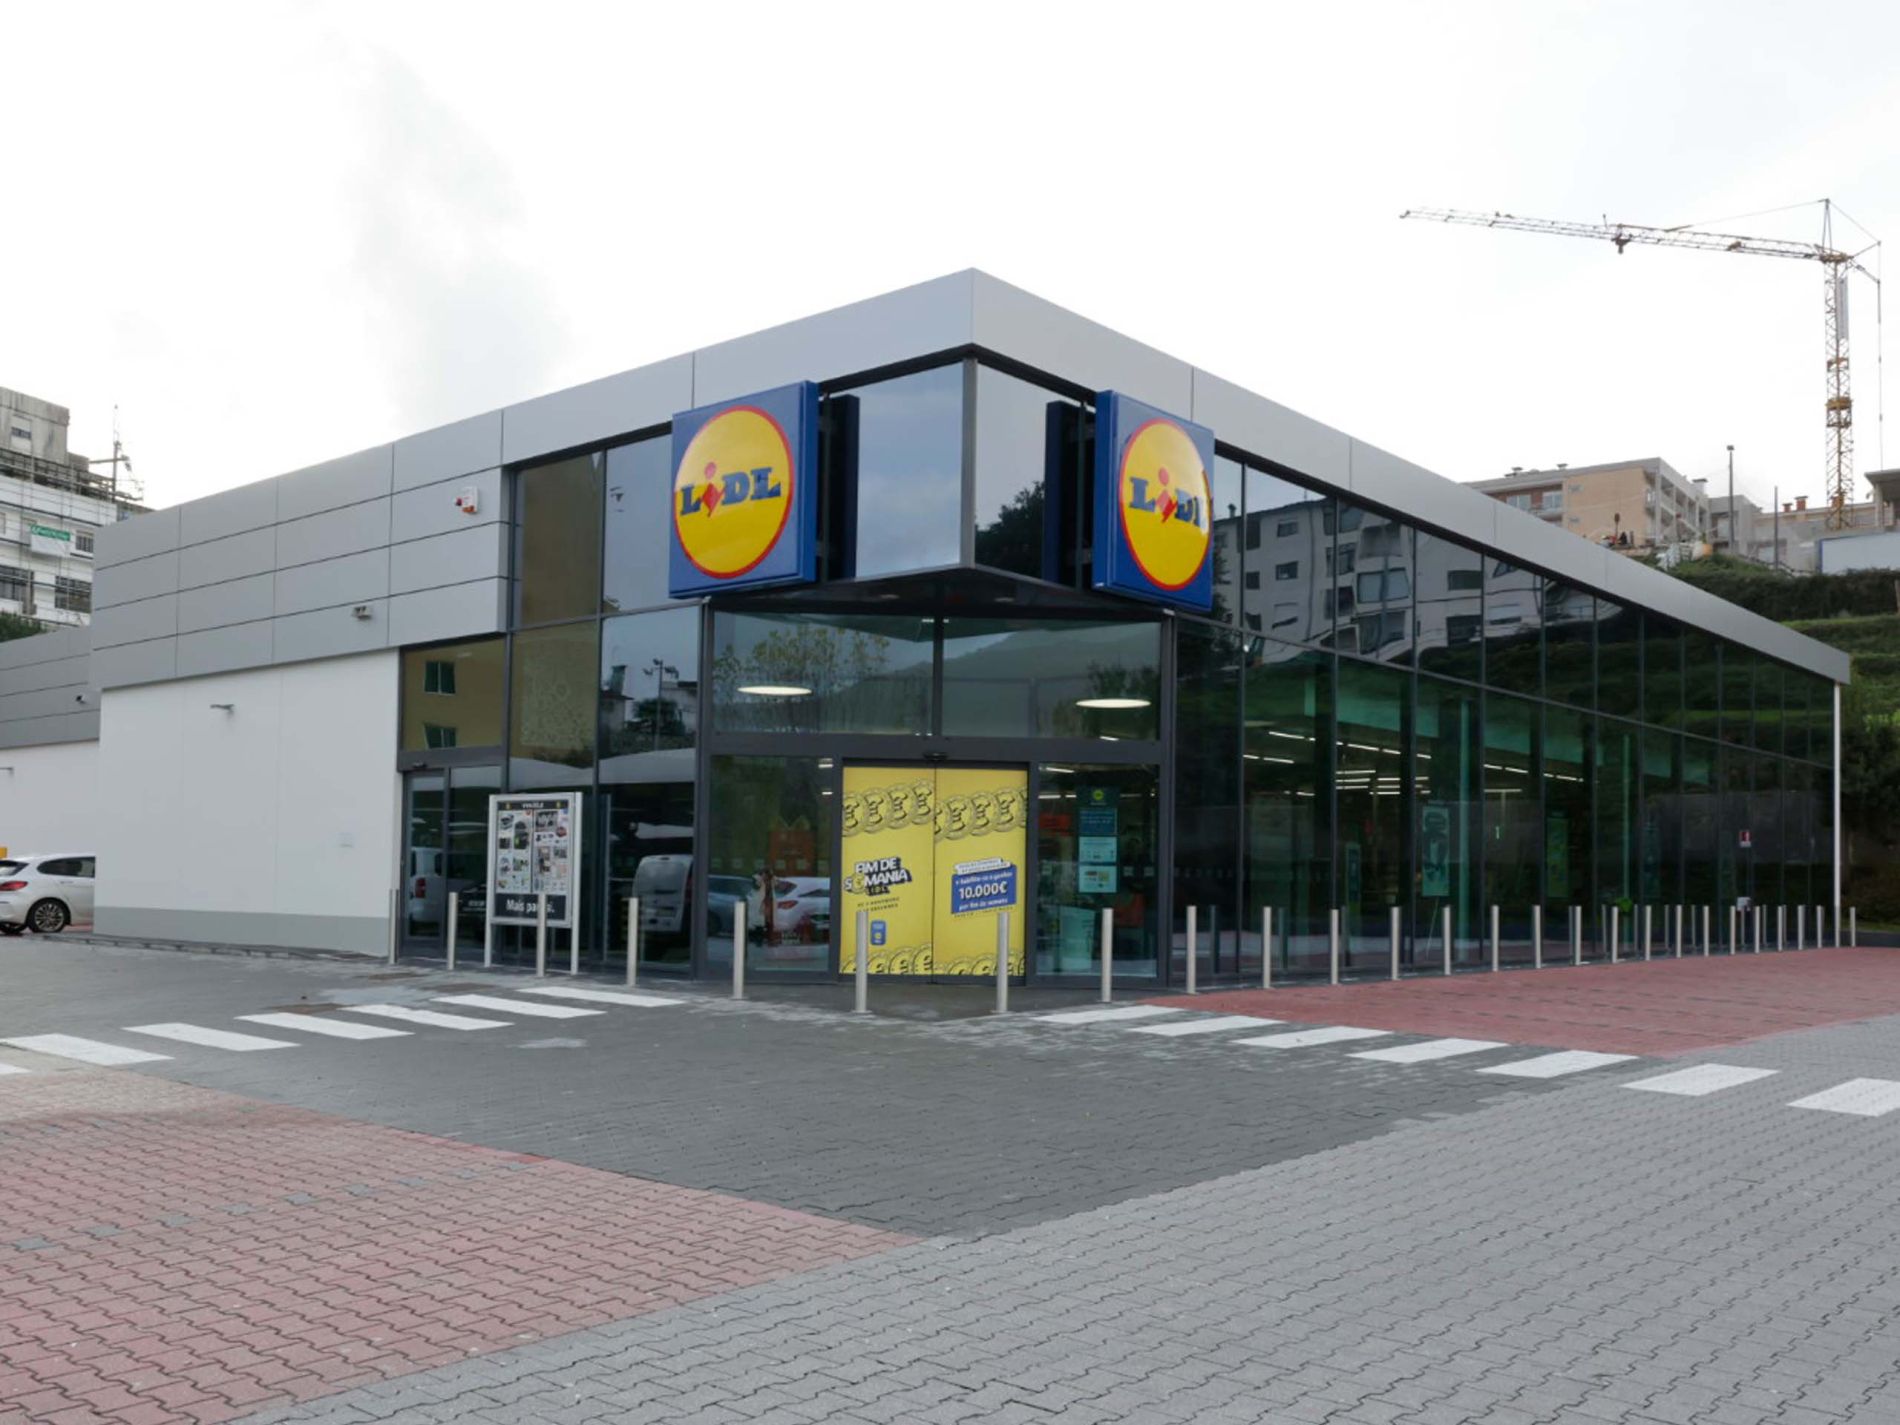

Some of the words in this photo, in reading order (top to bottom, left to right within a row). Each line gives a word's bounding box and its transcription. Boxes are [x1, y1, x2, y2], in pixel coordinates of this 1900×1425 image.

[680, 462, 782, 518] LIDL
[880, 857, 898, 871] DE
[958, 881, 1008, 899] 10.000€
